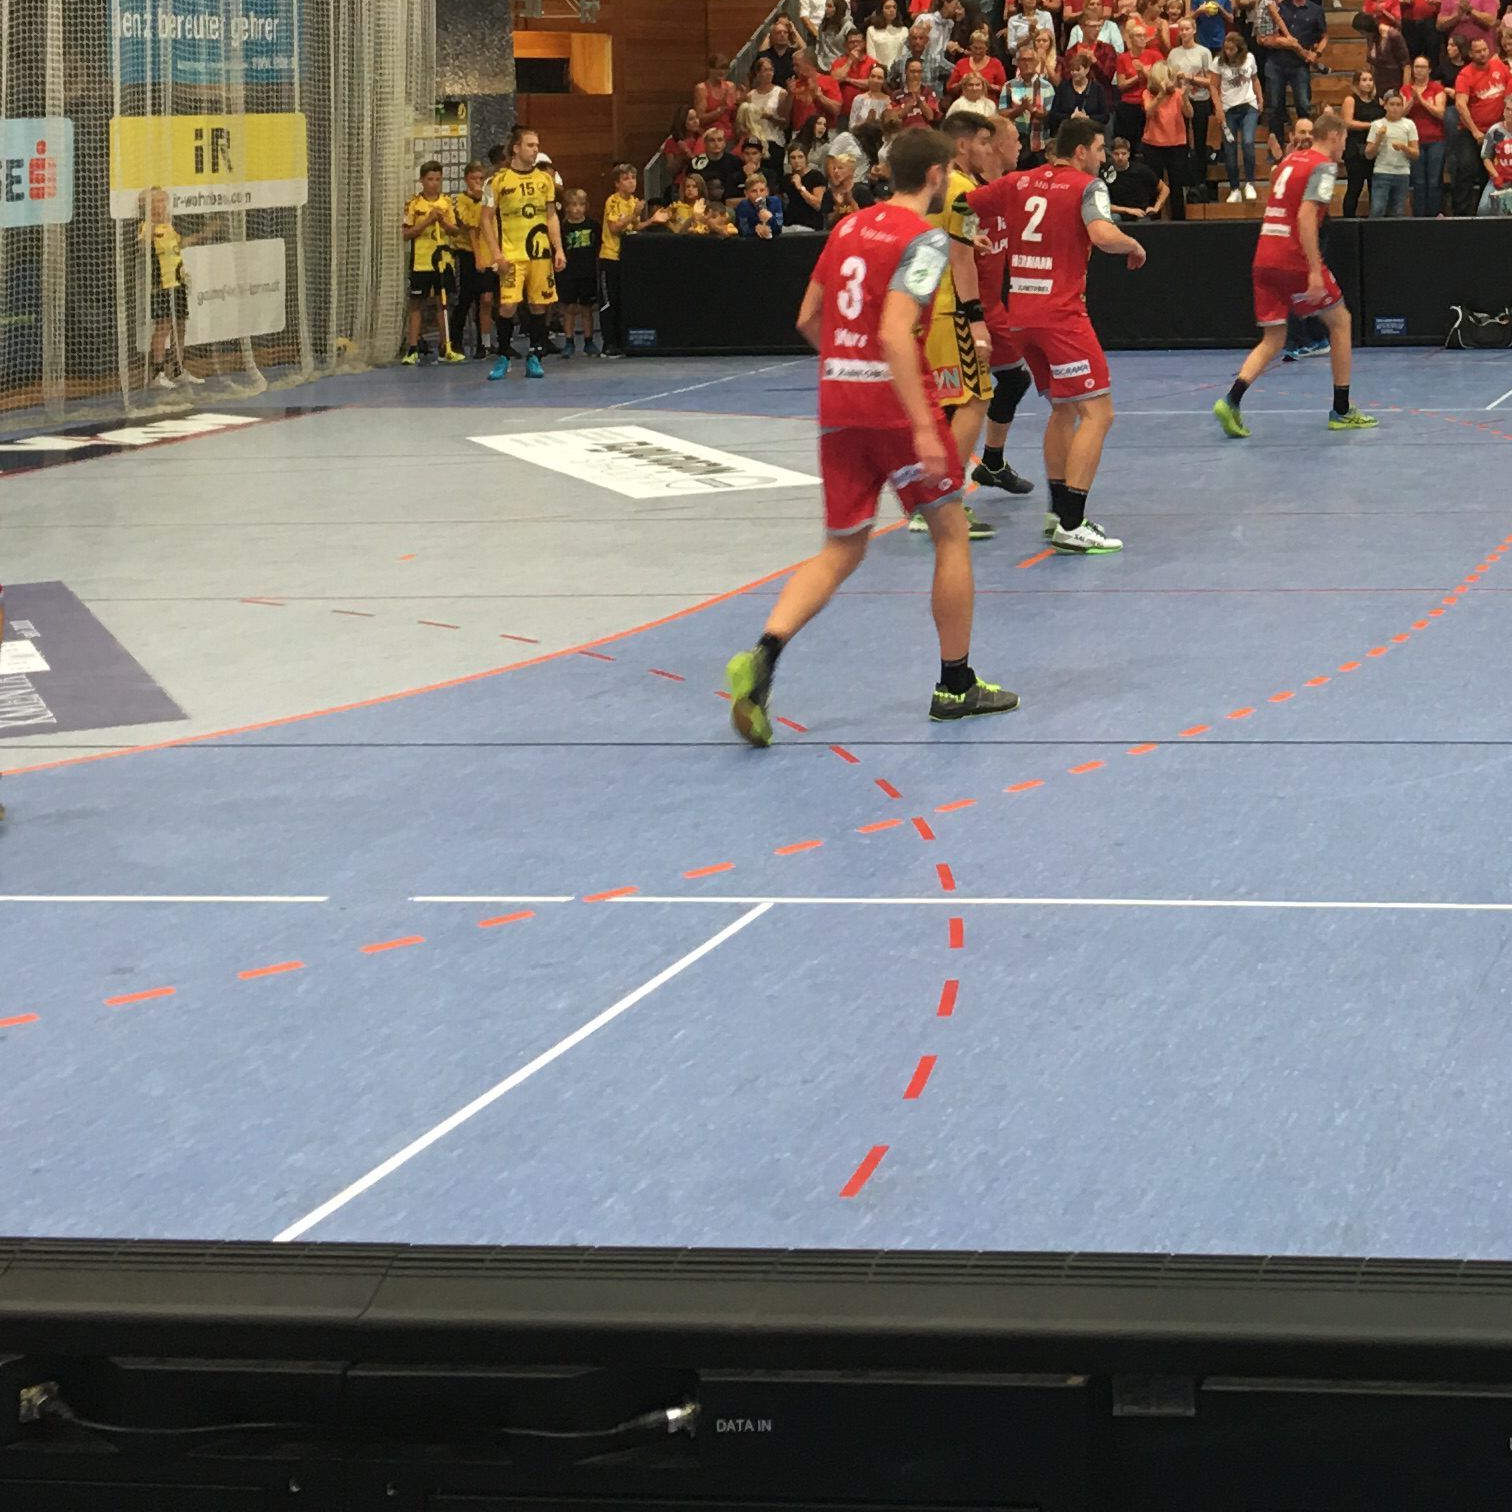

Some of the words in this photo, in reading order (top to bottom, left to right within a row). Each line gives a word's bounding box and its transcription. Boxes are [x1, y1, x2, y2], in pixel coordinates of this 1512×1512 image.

[519, 181, 535, 197] 15
[1273, 166, 1295, 199] 4
[1021, 195, 1048, 243] 2
[836, 255, 867, 321] 3
[716, 1418, 754, 1433] DATA
[757, 1419, 772, 1433] IN
